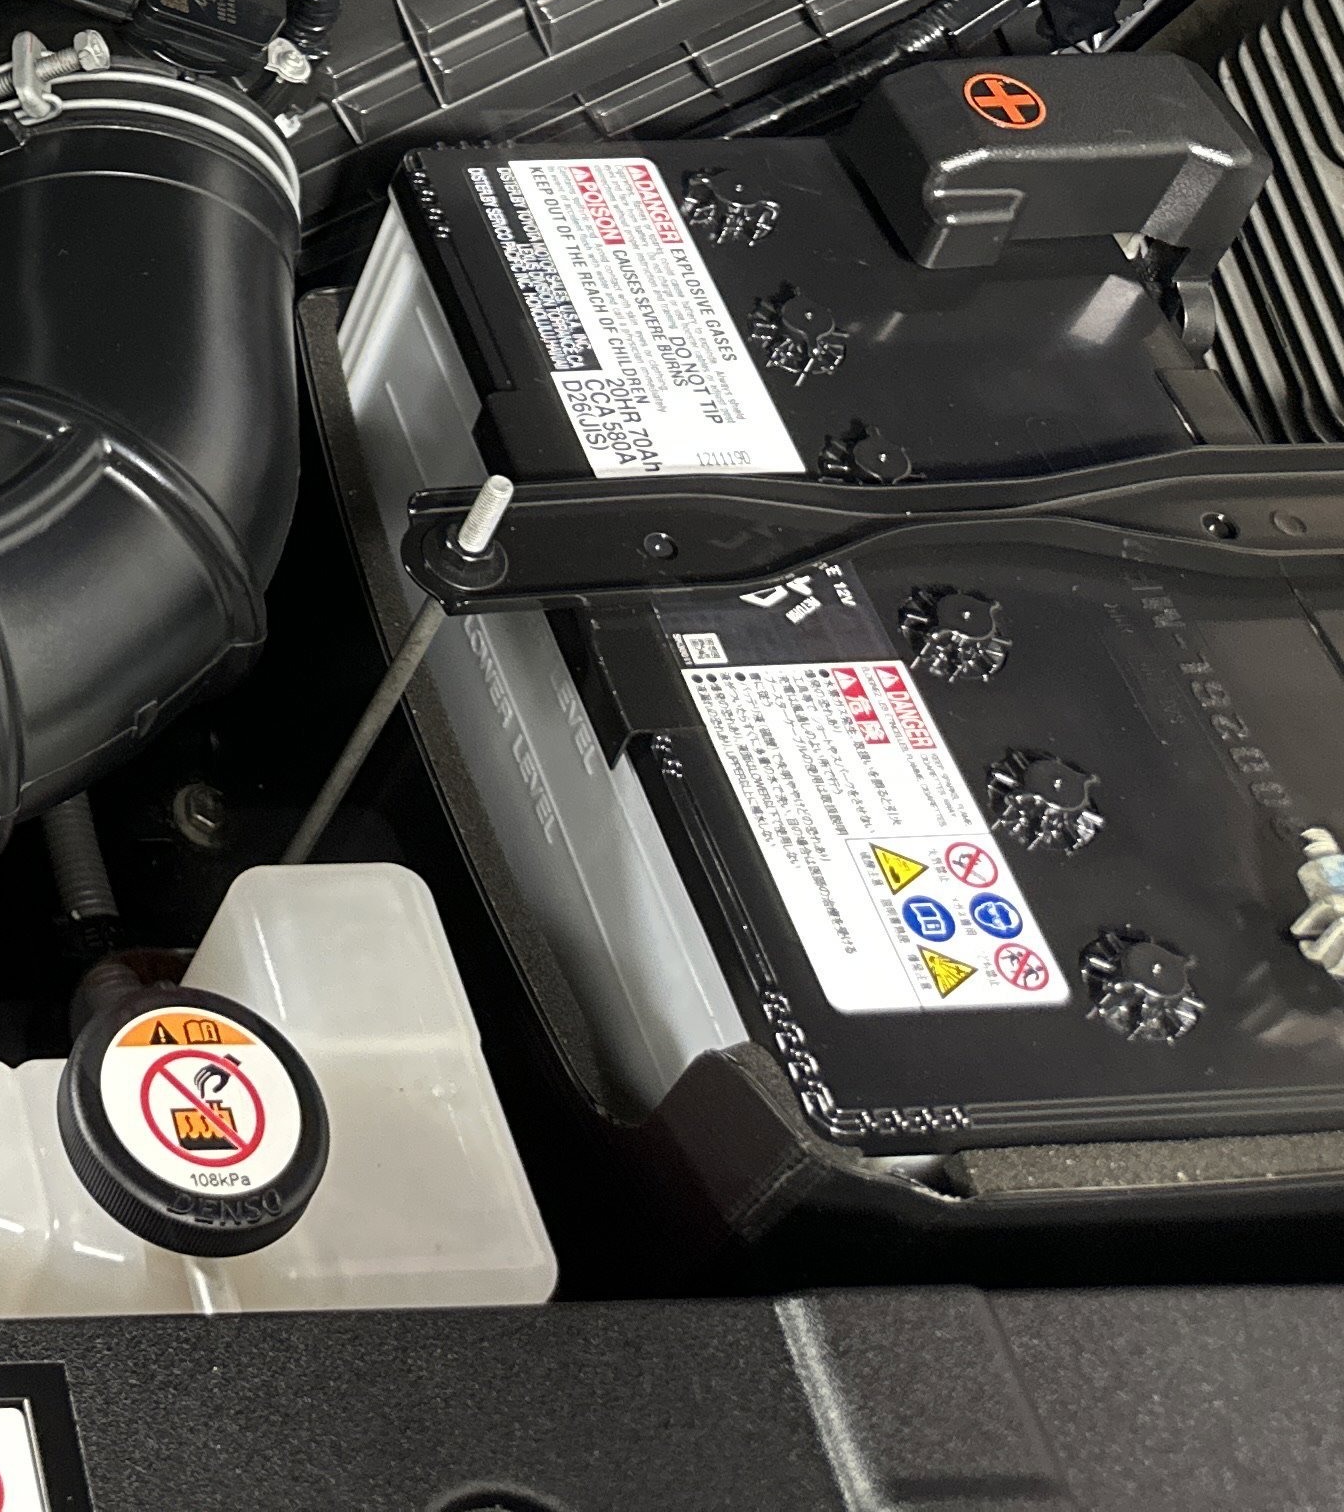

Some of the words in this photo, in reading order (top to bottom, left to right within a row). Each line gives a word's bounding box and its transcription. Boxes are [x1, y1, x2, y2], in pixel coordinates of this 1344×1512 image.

[526, 166, 554, 195] KEEP
[541, 198, 567, 222] OUT
[514, 209, 544, 242] TOYOTA
[529, 242, 559, 273] MOTOR
[554, 225, 576, 241] OF
[498, 241, 529, 272] PACIFIC
[514, 243, 542, 270] LEXUS
[563, 244, 588, 267] THE
[632, 180, 683, 242] DANGER
[668, 248, 716, 315] EXPLOSIVE
[703, 319, 739, 361] GASES
[575, 181, 623, 240] POISON
[610, 249, 647, 294] CAUSES
[632, 296, 669, 341] SEVERE
[655, 344, 690, 387] BURNS
[575, 271, 610, 313] REACH
[596, 316, 620, 334] OF
[666, 335, 693, 359] DO
[605, 337, 652, 404] CHILDREN
[679, 363, 711, 395] NOT
[559, 379, 612, 451] D26(JIS)
[580, 378, 619, 417] CCA
[600, 421, 640, 465] 580A
[602, 377, 643, 422] 20HR
[625, 427, 666, 472] 70Ah
[696, 399, 725, 424] TIP
[833, 581, 857, 606] 12V
[464, 614, 513, 729] LOWER
[513, 733, 555, 845] LEVEL
[843, 692, 888, 745] 危険
[884, 689, 933, 749] DANGER
[190, 1172, 252, 1188] 108kPa
[165, 1188, 284, 1227] DENSO
